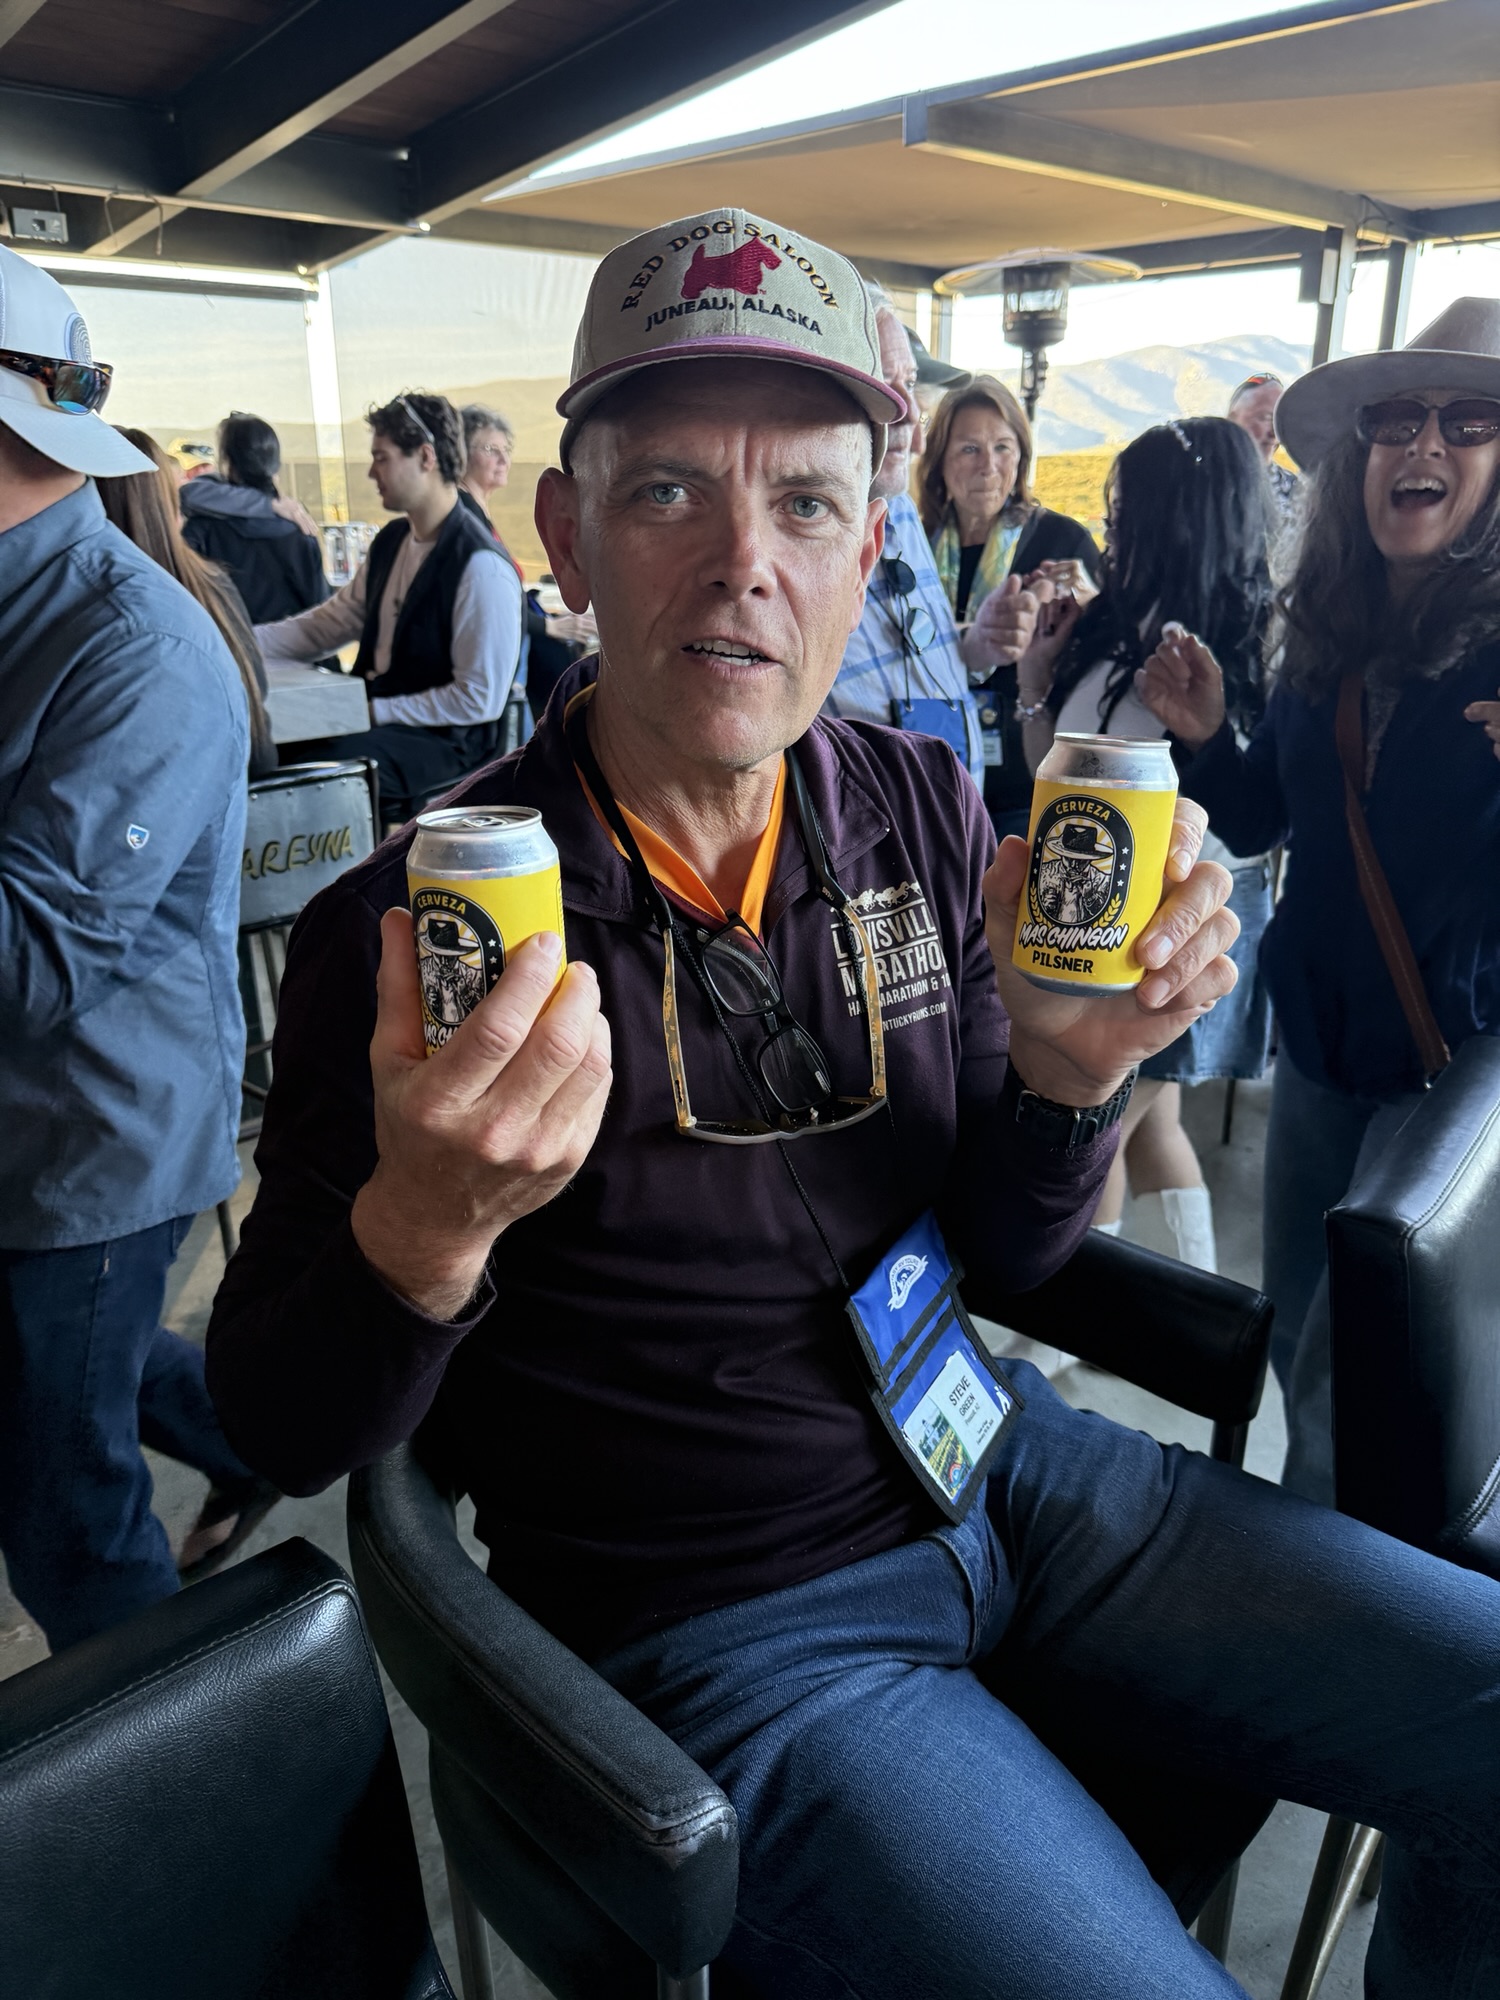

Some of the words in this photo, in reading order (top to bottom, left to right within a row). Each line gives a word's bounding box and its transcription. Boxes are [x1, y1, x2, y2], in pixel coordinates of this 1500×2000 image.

[620, 255, 664, 312] RED
[667, 220, 735, 252] DOG
[743, 221, 840, 311] SALOON
[645, 296, 735, 332] JUNEAU,
[741, 297, 823, 336] ALASKA
[1055, 800, 1111, 822] CERVEZA
[416, 893, 467, 916] CERVEZA
[1018, 922, 1046, 949] MAS
[1046, 923, 1130, 953] CHINGON
[1032, 950, 1094, 974] PILSNER
[930, 976, 939, 991] &
[948, 1375, 971, 1407] STEVE
[958, 1392, 976, 1417] GREEN
